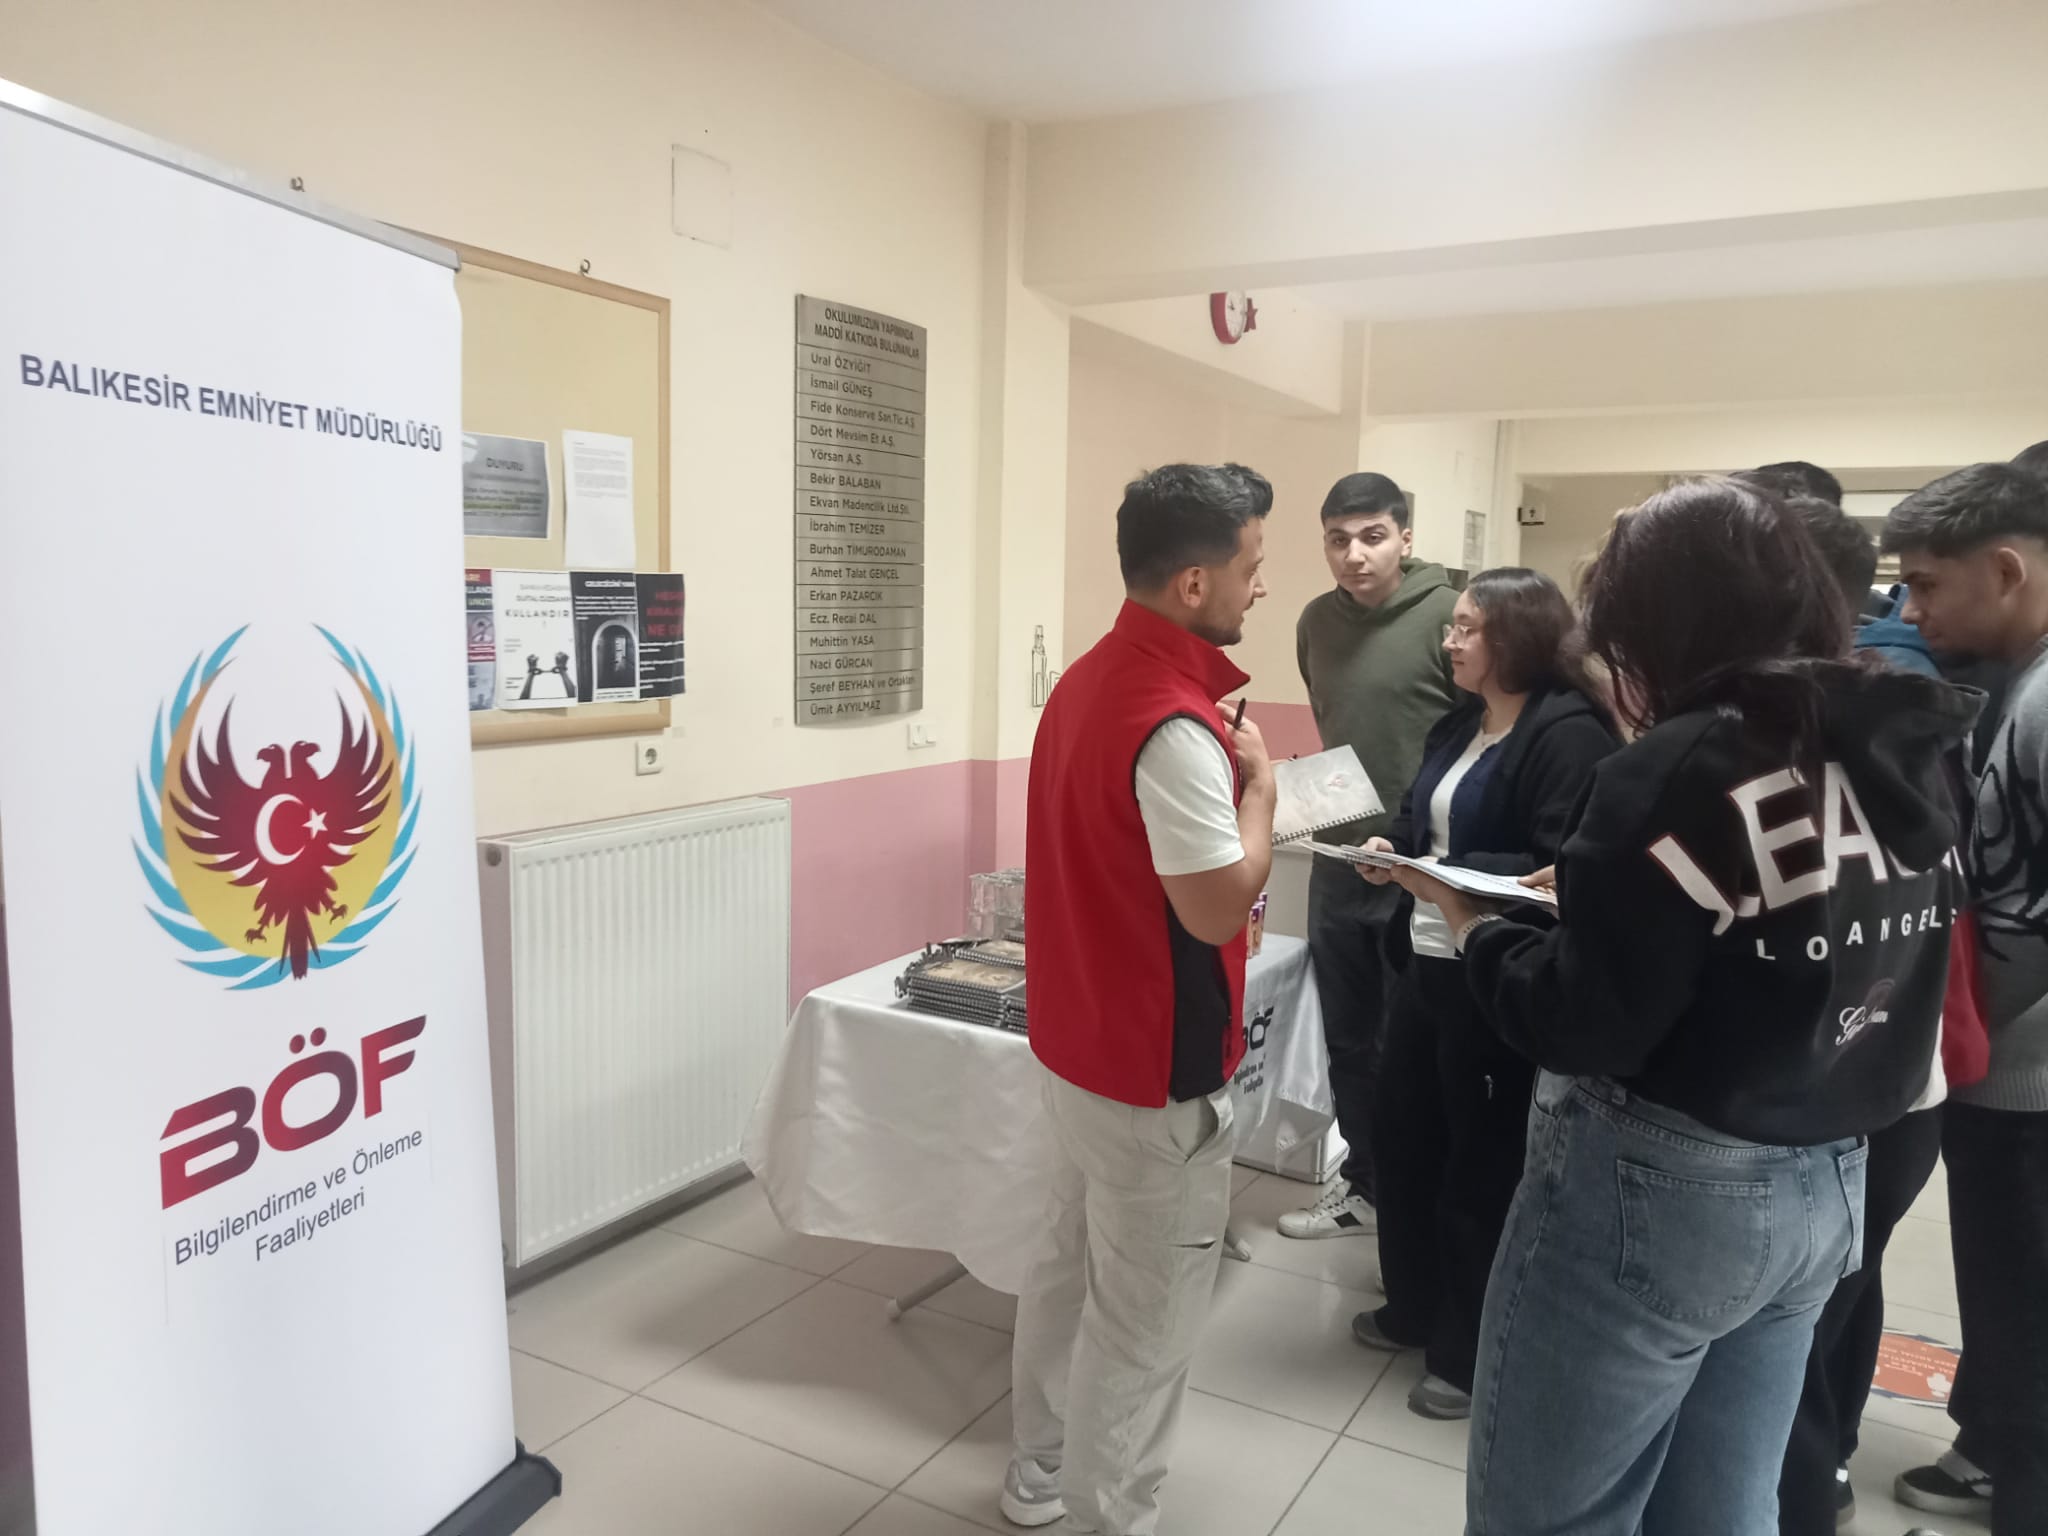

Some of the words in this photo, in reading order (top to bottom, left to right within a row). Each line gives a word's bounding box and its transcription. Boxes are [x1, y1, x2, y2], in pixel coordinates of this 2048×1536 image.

[811, 353, 831, 367] Ural
[811, 374, 839, 391] İsmail
[842, 381, 873, 398] GÜNEŞ
[19, 353, 191, 412] BALIKESİR
[199, 386, 308, 430] EMNİYET
[316, 407, 442, 452] MÜDÜRLÜĞÜ
[811, 400, 832, 413] Fide
[836, 403, 875, 420] Konserve
[810, 424, 832, 437] Dört
[836, 428, 868, 441] Mevsim
[811, 448, 843, 462] Yörsan
[810, 473, 835, 485] Bekir
[839, 475, 881, 490] BALABAN
[810, 496, 839, 508] Ekvan
[810, 518, 846, 532] İbrahim
[810, 544, 844, 556] Burhan
[811, 567, 842, 578] Ahmet
[845, 567, 867, 578] Talat
[810, 590, 837, 601] Erkan
[810, 613, 829, 624] Ecz.
[832, 613, 857, 624] Recai
[860, 613, 877, 624] DAL
[810, 636, 848, 648] Muhittin
[810, 658, 831, 670] Naci
[835, 656, 873, 669] GÜRCAN
[810, 680, 835, 694] Şeref
[838, 679, 874, 691] BEYHAN
[810, 702, 833, 716] Ümit
[836, 699, 881, 714] AYYILMAZ
[160, 1014, 427, 1211] BÖF
[175, 1181, 317, 1266] Bilgilendirme
[323, 1167, 346, 1190] ve
[353, 1130, 423, 1176] Önleme
[255, 1187, 366, 1262] Faaliyetleri
